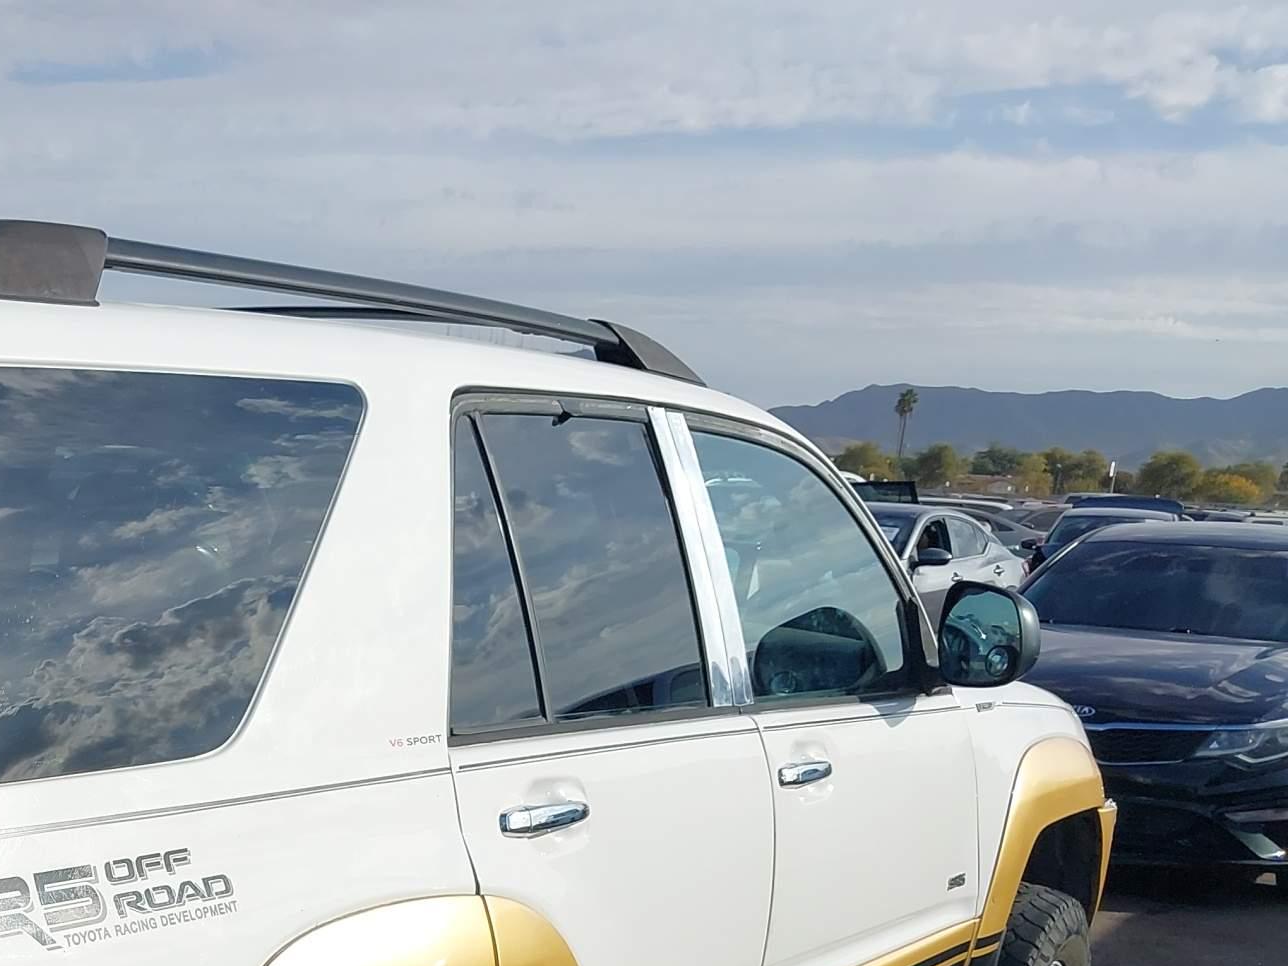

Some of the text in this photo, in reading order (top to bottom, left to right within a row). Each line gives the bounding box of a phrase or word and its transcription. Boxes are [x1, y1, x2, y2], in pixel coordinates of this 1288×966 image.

[388, 733, 442, 748] V6 SPORT
[104, 847, 191, 885] OFF
[113, 873, 234, 918] ROAD
[63, 900, 238, 948] TOYOTA RACING DEVELOPMENT
